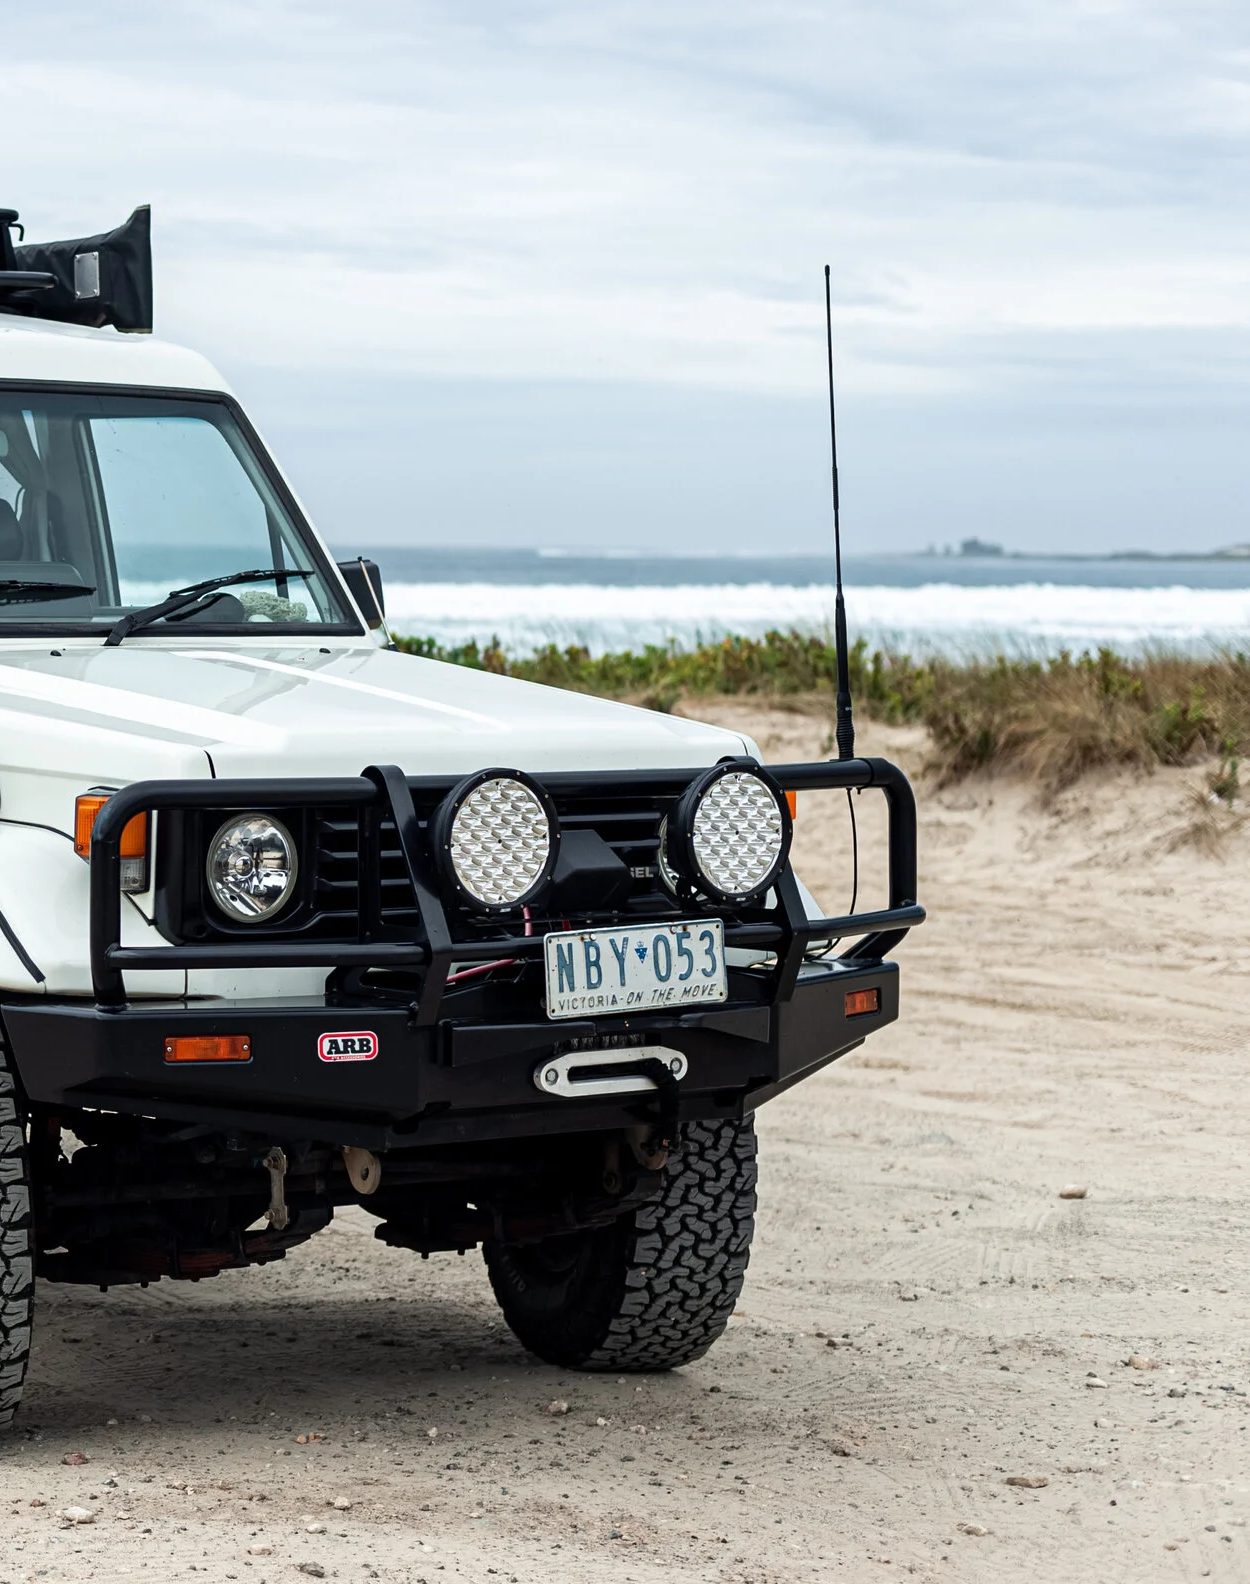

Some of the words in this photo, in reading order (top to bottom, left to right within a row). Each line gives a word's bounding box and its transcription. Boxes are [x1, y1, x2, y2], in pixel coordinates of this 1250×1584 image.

[556, 937, 629, 993] NBY
[653, 930, 717, 982] 053
[652, 988, 673, 1000] THE
[681, 983, 717, 998] MOVE
[327, 1038, 372, 1055] ARB
